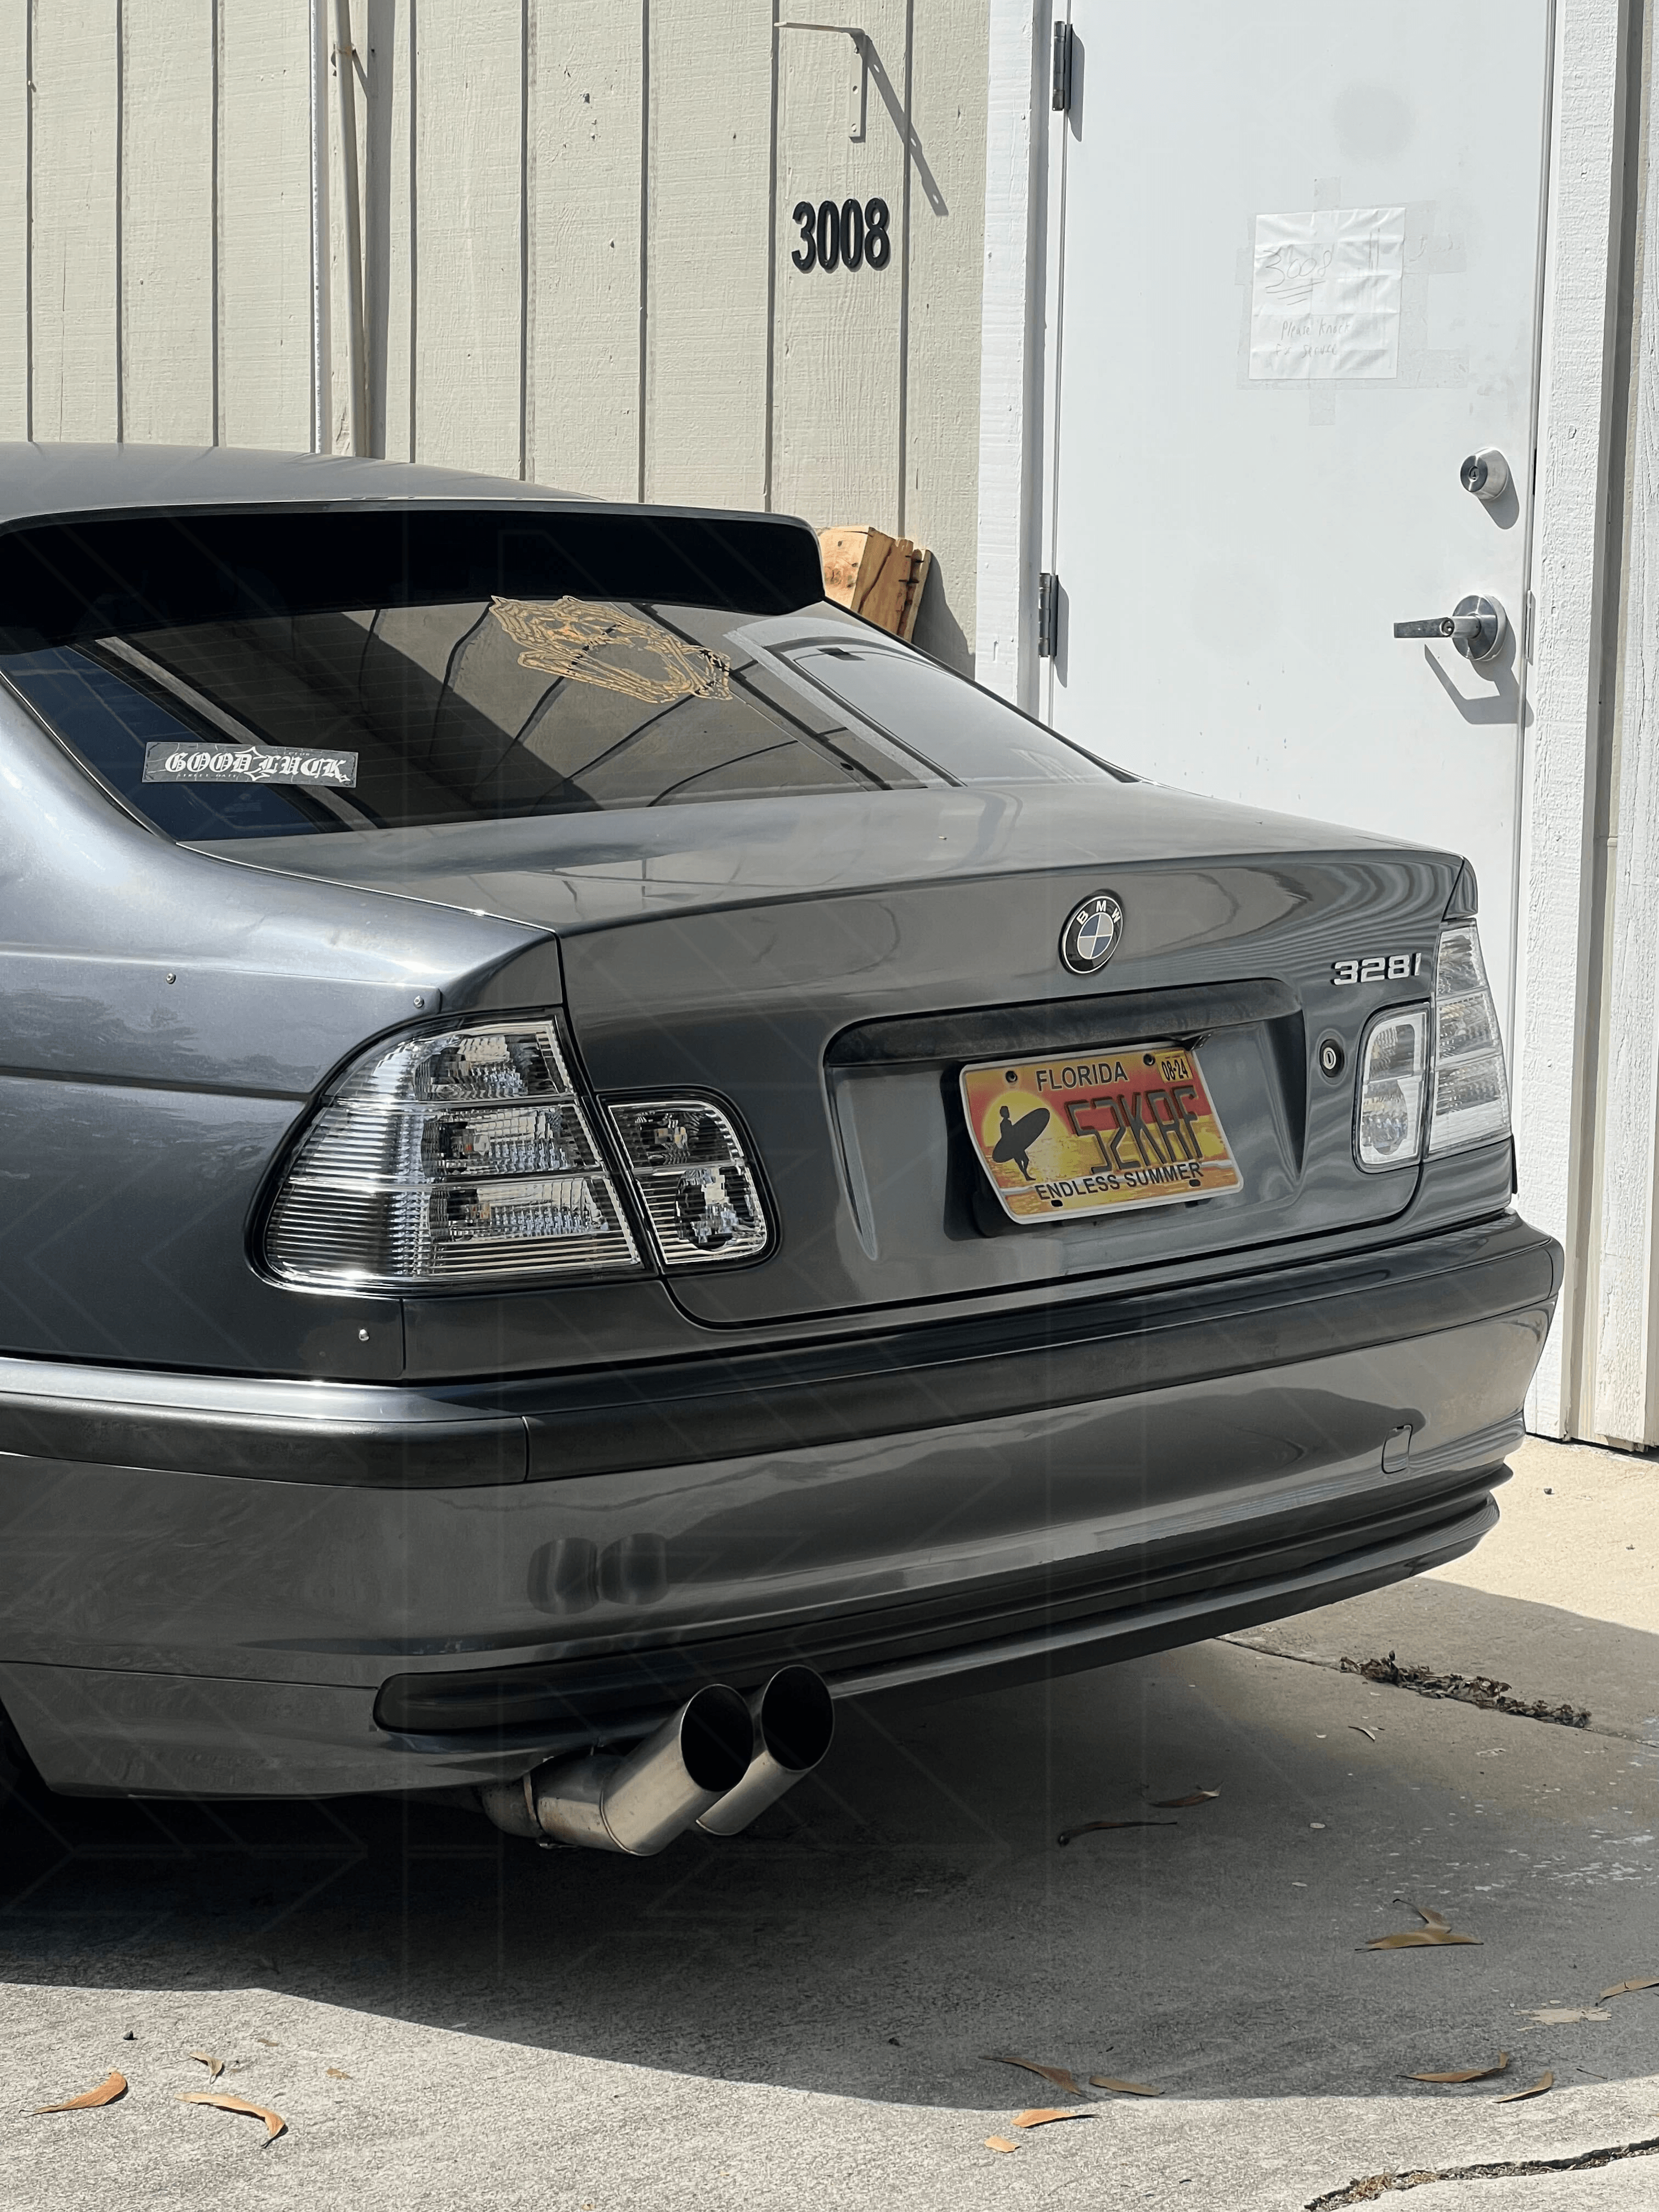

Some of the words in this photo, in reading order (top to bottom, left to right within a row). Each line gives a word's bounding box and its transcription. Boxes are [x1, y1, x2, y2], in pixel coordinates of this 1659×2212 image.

[791, 198, 890, 271] 3008
[1263, 250, 1333, 289] 3008
[165, 752, 253, 773] GOOD
[259, 755, 351, 783] LUCK
[1076, 900, 1121, 925] BMW
[1036, 1062, 1128, 1092] FLORIDA
[1065, 1086, 1203, 1173] 52KAF
[1034, 1175, 1120, 1200] ENDLESS
[1125, 1162, 1204, 1187] SUMMER
